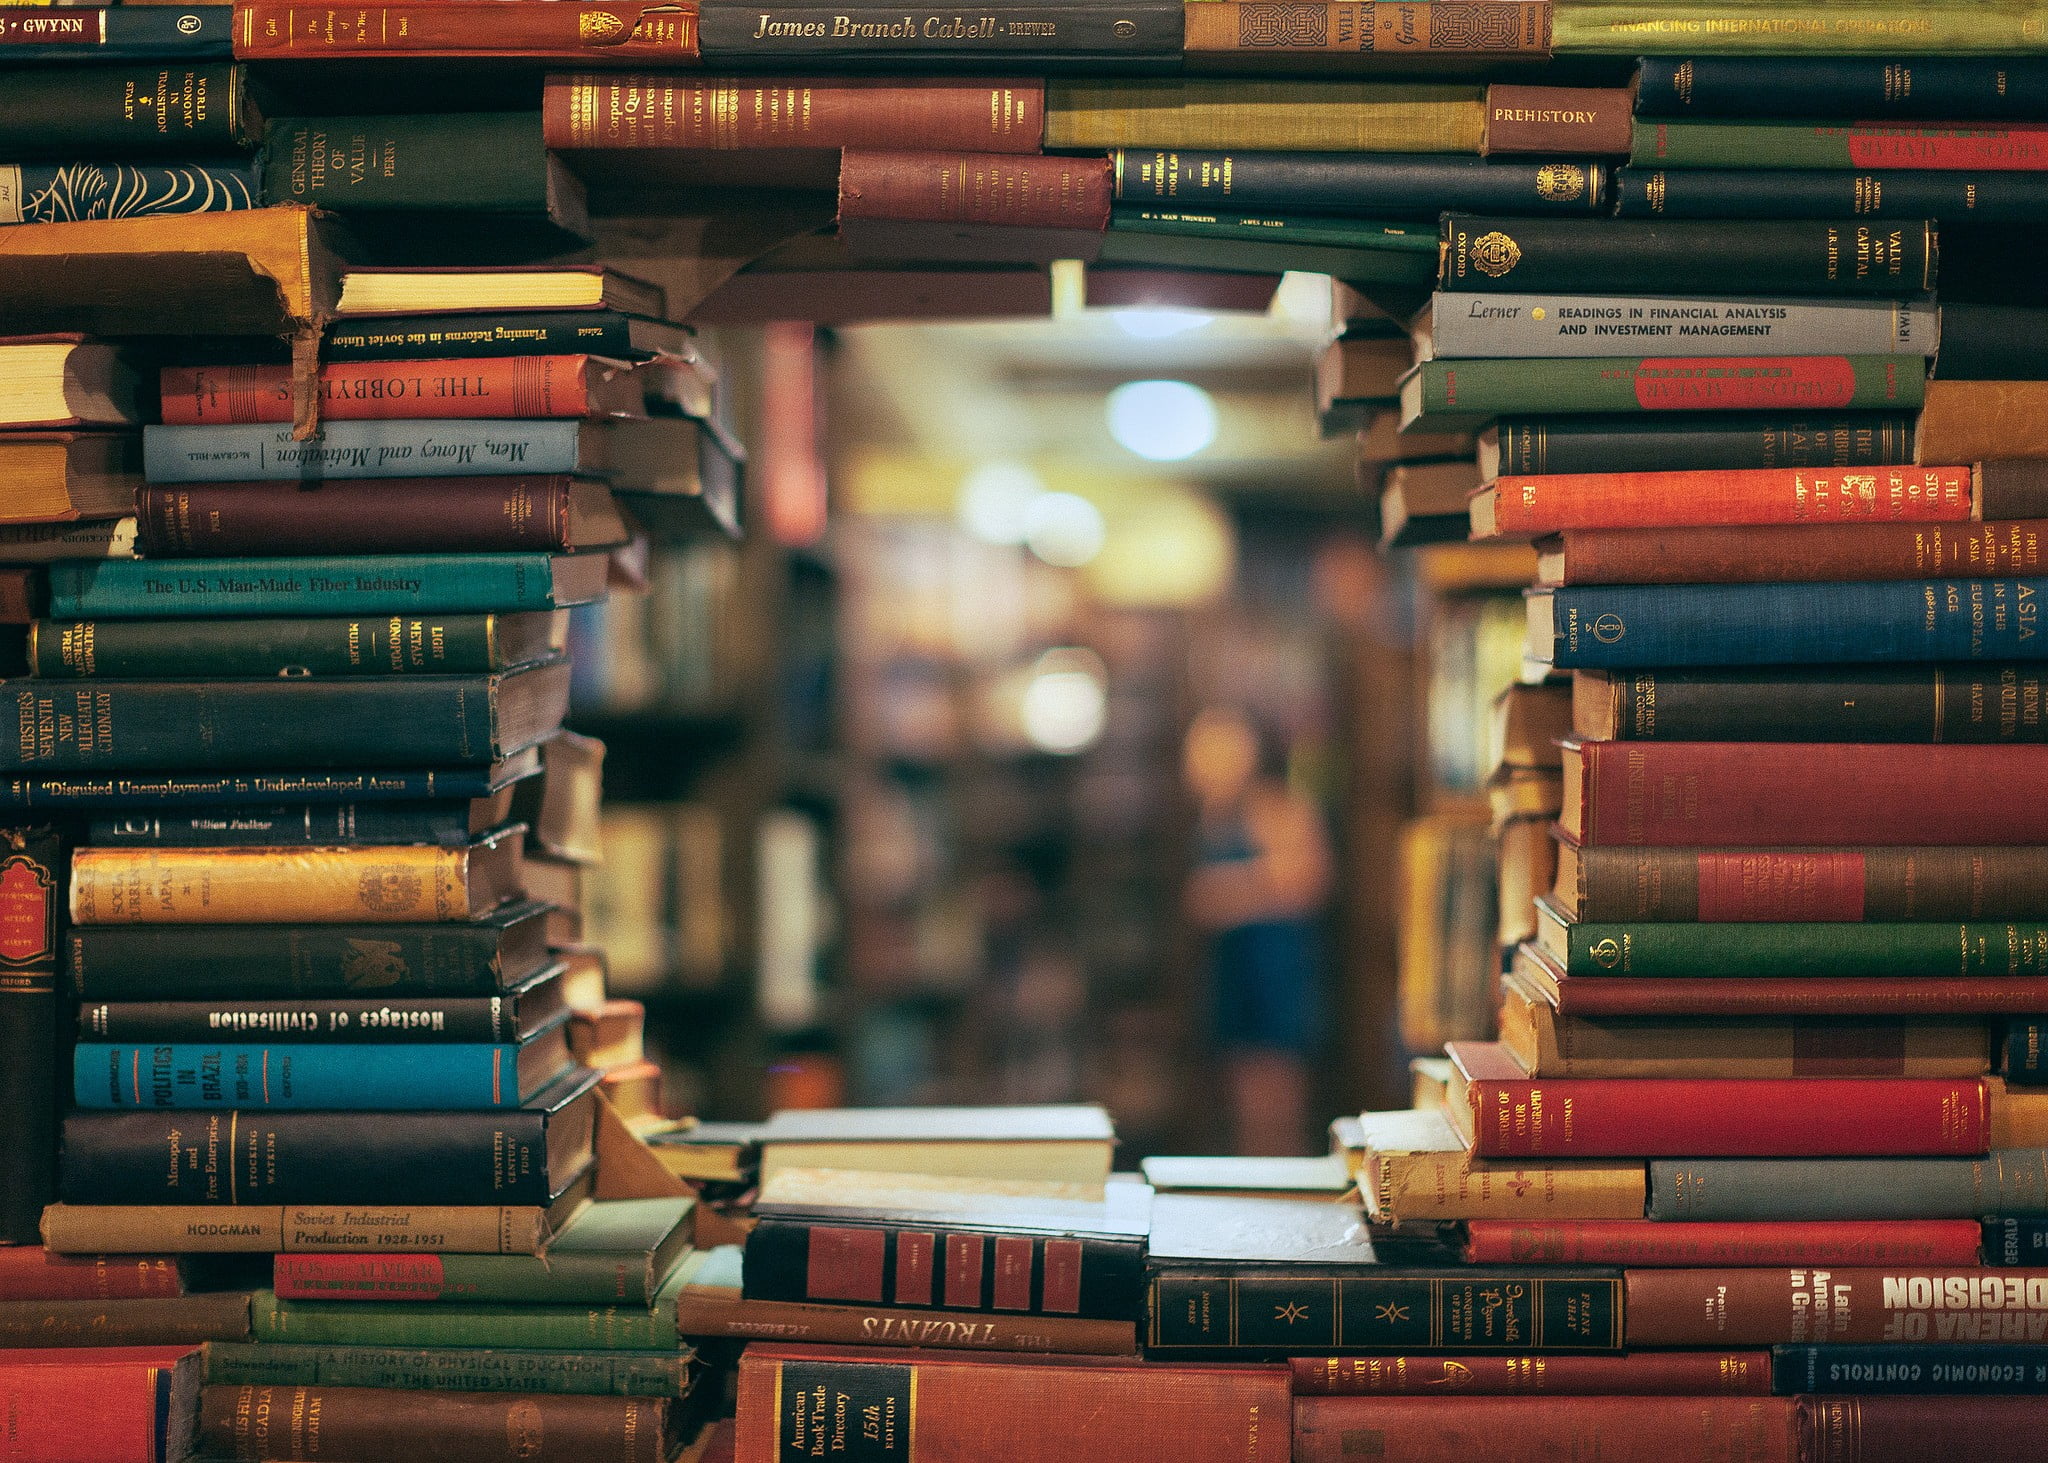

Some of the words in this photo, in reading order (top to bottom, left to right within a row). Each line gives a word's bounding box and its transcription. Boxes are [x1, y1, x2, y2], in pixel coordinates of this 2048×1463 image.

[23, 18, 84, 33] GWYNN
[265, 18, 278, 36] Galt
[308, 18, 318, 34] The
[325, 10, 337, 44] Gathering
[341, 21, 350, 31] of
[357, 27, 367, 43] The
[399, 16, 408, 37] Booth
[753, 14, 827, 39] James
[830, 15, 918, 39] Branch
[922, 15, 997, 39] Cabell
[1008, 21, 1057, 37] BREWER
[1338, 8, 1355, 44] WILL
[1359, 0, 1376, 51] ROGERS
[1526, 6, 1536, 45] MESSNER
[1611, 19, 1701, 34] FINANCING
[1705, 18, 1828, 34] INTERNATIONAL
[1835, 18, 1934, 34] OPERATIONS
[125, 81, 135, 121] STALEY
[157, 69, 169, 134] TRANSITION
[170, 90, 179, 104] IN
[184, 71, 195, 129] ECONOMY
[196, 77, 207, 121] WORLD
[607, 78, 620, 139] Corporate
[990, 90, 1000, 135] PRINCETON
[1004, 88, 1013, 136] UNIVERSITY
[1016, 100, 1025, 126] PRESS
[1494, 107, 1598, 125] PREHISTORY
[291, 130, 309, 196] GENERAL
[311, 130, 328, 191] THEORY
[331, 148, 346, 171] OF
[350, 133, 367, 186] VALUE
[383, 138, 397, 179] PERRY
[1141, 163, 1151, 183] THE
[1168, 152, 1180, 172] LAW
[1155, 152, 1166, 197] MICHIGAN
[1168, 171, 1180, 197] POOR
[1202, 161, 1211, 188] BRUCE
[1181, 214, 1217, 223] THINKETH
[1457, 231, 1467, 279] OXFORD
[1856, 226, 1870, 280] CAPITAL
[1874, 239, 1884, 265] AND
[1889, 230, 1902, 276] VALUE
[1468, 300, 1522, 320] Lerner
[1558, 307, 1622, 320] READINGS
[1629, 307, 1643, 320] IN
[1650, 307, 1719, 320] FINANCIAL
[1725, 307, 1787, 320] ANALYSIS
[1899, 299, 1910, 342] IRWIN
[332, 334, 366, 347] Union
[367, 333, 405, 345] Soviet
[407, 332, 427, 344] the
[429, 331, 443, 342] in
[444, 327, 494, 342] Reforms
[496, 326, 548, 342] Planning
[1558, 324, 1588, 336] AND
[1594, 324, 1673, 336] INVESTMENT
[1679, 324, 1772, 336] MANAGEMENT
[277, 378, 423, 401] LOBBYIS
[433, 376, 491, 398] THE
[276, 443, 370, 468] Motivation
[380, 446, 413, 466] and
[420, 438, 477, 464] Money
[486, 441, 530, 461] Men,
[1857, 427, 1873, 456] THE
[1908, 484, 1921, 503] OF
[1945, 479, 1959, 509] THE
[1915, 533, 1923, 568] NORTON
[1969, 537, 1980, 563] ASIA
[1984, 525, 1995, 574] EASTERN
[2026, 532, 2037, 566] FRUIT
[143, 580, 173, 594] The
[179, 580, 212, 594] U.S.
[218, 579, 302, 593] Man-Made
[310, 578, 349, 593] Fiber
[356, 577, 422, 595] Industry
[1947, 584, 1959, 613] AGE
[1994, 583, 2006, 598] IN
[1971, 583, 1984, 658] EUROPEAN
[1995, 603, 2006, 632] THE
[2017, 583, 2037, 642] ASIA
[349, 622, 361, 665] MULLER
[411, 620, 424, 667] METALS
[431, 625, 445, 661] LIGHT
[1568, 607, 1579, 654] PRAEGER
[62, 629, 73, 666] PRESS
[1971, 682, 1983, 724] HAZEN
[2023, 679, 2039, 727] FRENCH
[38, 698, 55, 759] SEVENTH
[59, 713, 74, 743] NEW
[41, 779, 113, 797] "Disguised
[118, 778, 230, 798] Unemployment"
[235, 778, 249, 792] in
[253, 776, 363, 794] Underdeveloped
[368, 776, 406, 791] Areas
[208, 1010, 318, 1032] Civilisation
[329, 1010, 350, 1032] of
[360, 1006, 445, 1032] Hostages
[152, 1045, 174, 1107] POLITICS
[176, 1069, 196, 1085] IN
[202, 1050, 223, 1101] BRAZIL
[1515, 1102, 1527, 1137] COLOR
[166, 1128, 181, 1187] Monopoly
[205, 1115, 220, 1170] Enterprise
[267, 1131, 277, 1185] WATKINS
[186, 1147, 198, 1170] and
[249, 1130, 259, 1188] STOCKING
[494, 1131, 504, 1190] TWENTIETH
[507, 1136, 517, 1184] CENTURY
[521, 1145, 530, 1176] FUND
[205, 1172, 219, 1200] Free
[187, 1223, 262, 1237] HODGMAN
[294, 1211, 335, 1226] Soviet
[342, 1211, 411, 1226] Industrial
[293, 1230, 370, 1246] Production
[376, 1232, 446, 1247] 1928-1951
[2004, 1217, 2019, 1265] GERALD
[1453, 1293, 1461, 1306] OF
[1716, 1285, 1727, 1332] Prentice
[1812, 1269, 1832, 1344] America
[1834, 1284, 1852, 1333] Latin
[1882, 1276, 2048, 1310] DECISION
[1188, 1299, 1198, 1326] PRESS
[1200, 1290, 1210, 1335] MOHAWK
[1453, 1307, 1461, 1334] PERU
[1463, 1285, 1474, 1341] CONQUEROR
[1567, 1296, 1577, 1332] SHAY
[1580, 1292, 1592, 1337] FRANK
[1705, 1298, 1715, 1322] Hall
[859, 1315, 998, 1346] TRUANTS
[1883, 1312, 1929, 1342] OF
[517, 1358, 604, 1373] EDUCATION
[1829, 1363, 1923, 1381] CONTROLS
[1931, 1365, 2025, 1384] ECONOMIC
[810, 1384, 827, 1424] Trade
[790, 1390, 807, 1451] American
[831, 1390, 851, 1453] Directory
[862, 1402, 882, 1441] 15th
[885, 1396, 896, 1451] EDITION
[810, 1424, 827, 1458] Book
